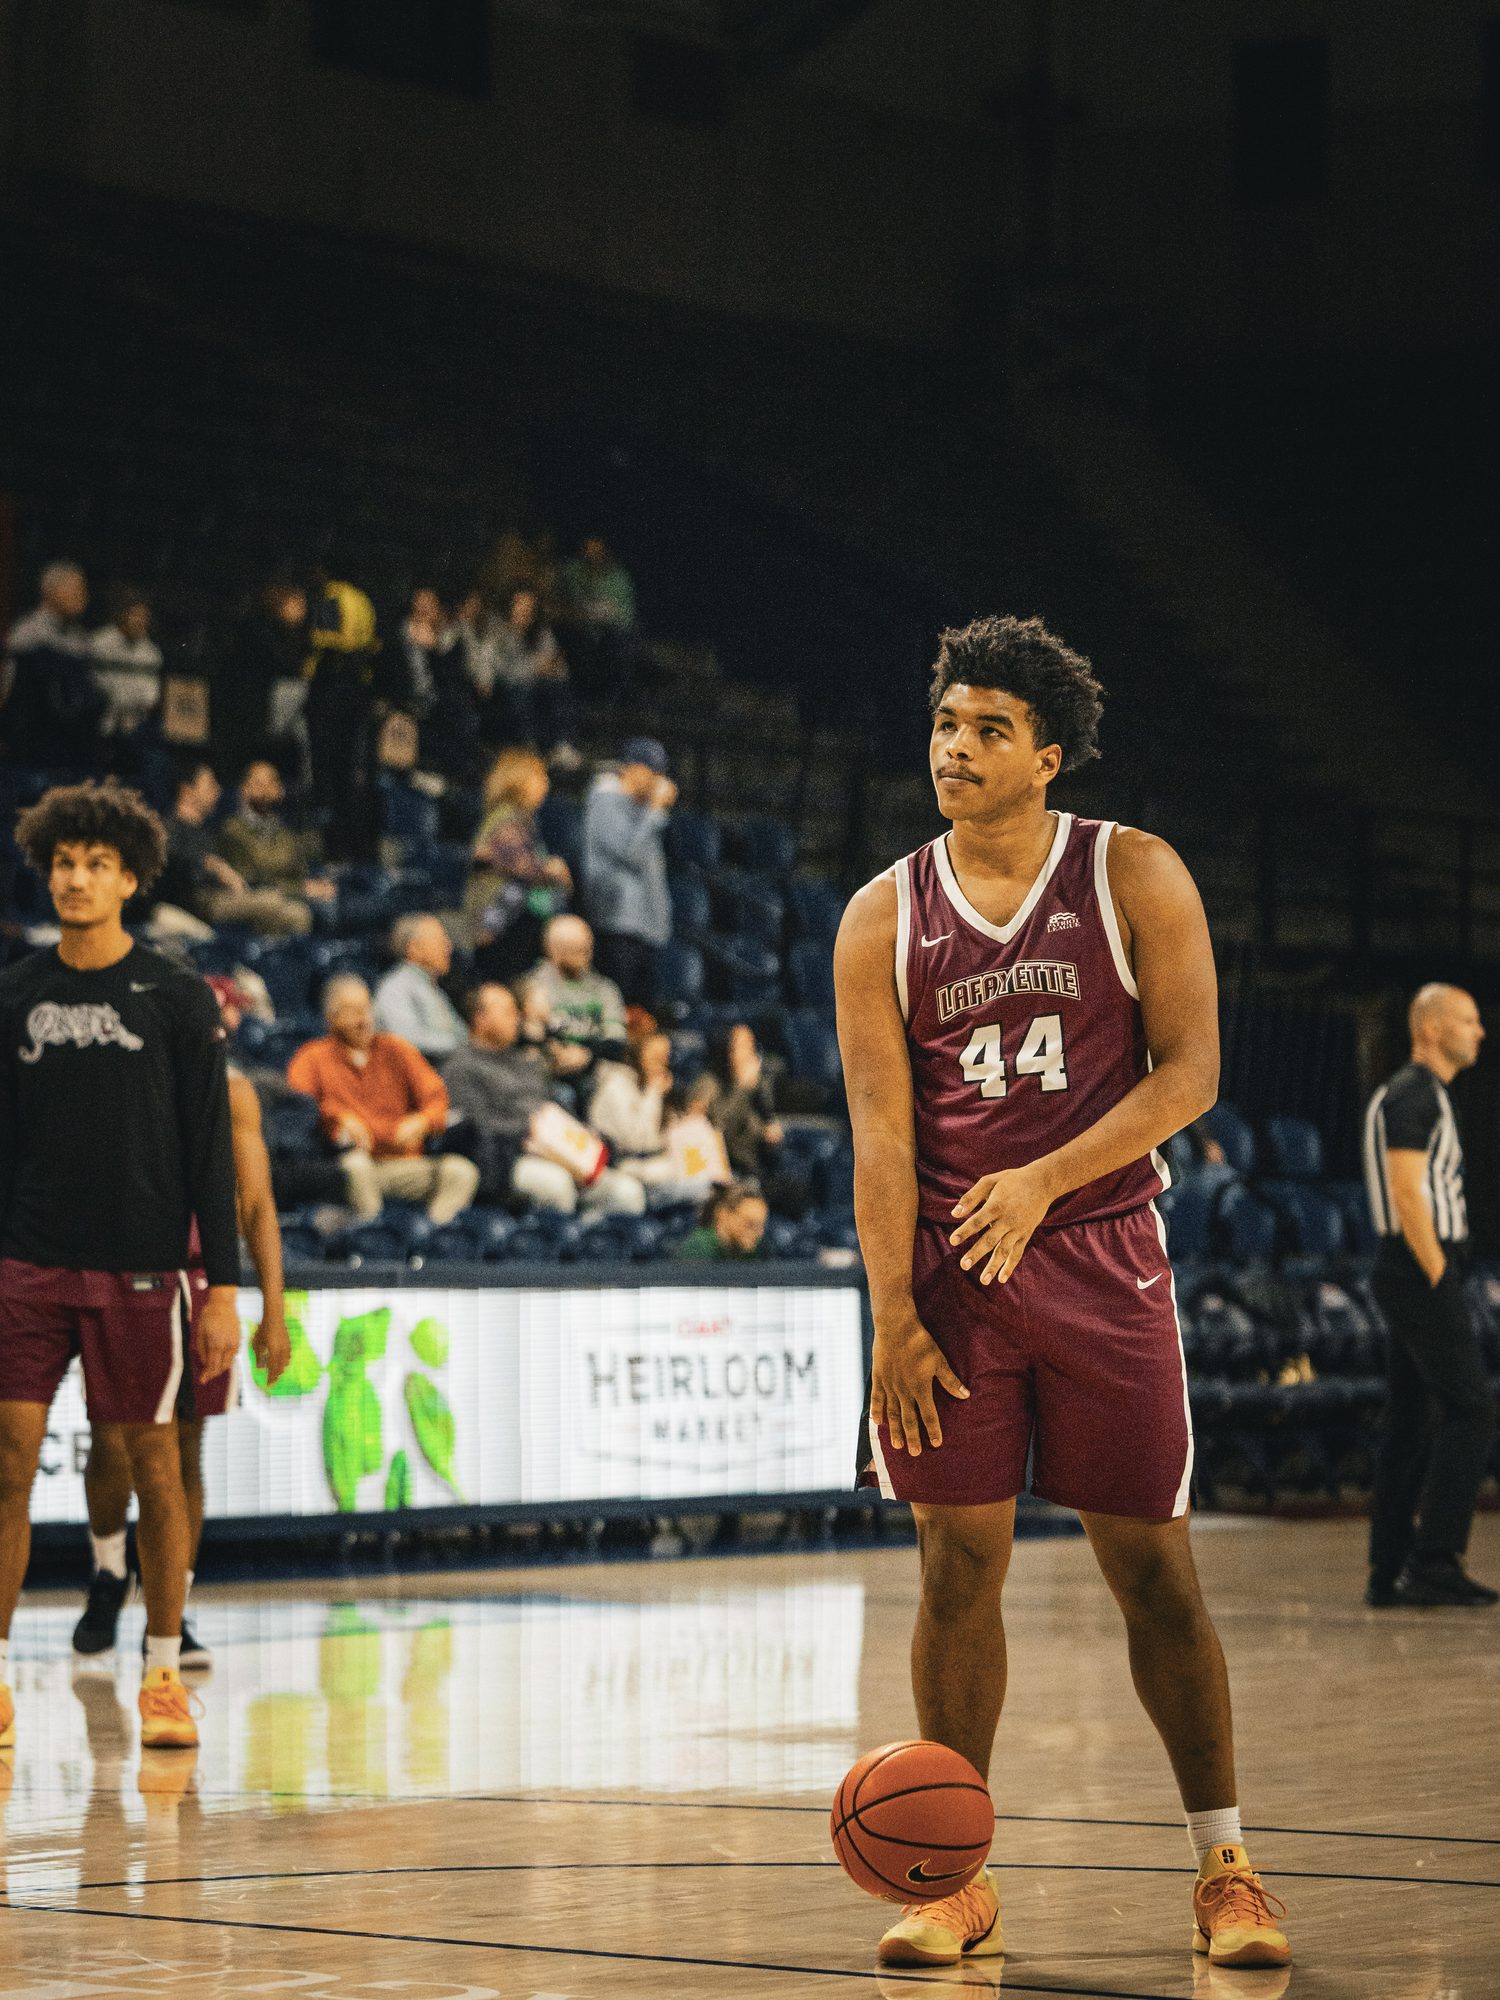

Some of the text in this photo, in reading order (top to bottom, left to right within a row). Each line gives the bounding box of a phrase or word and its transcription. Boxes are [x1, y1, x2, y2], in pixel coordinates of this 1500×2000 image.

[936, 960, 1081, 1024] LAFAYETTE
[959, 1014, 1067, 1098] 44
[587, 1350, 819, 1406] HEIRLOOM
